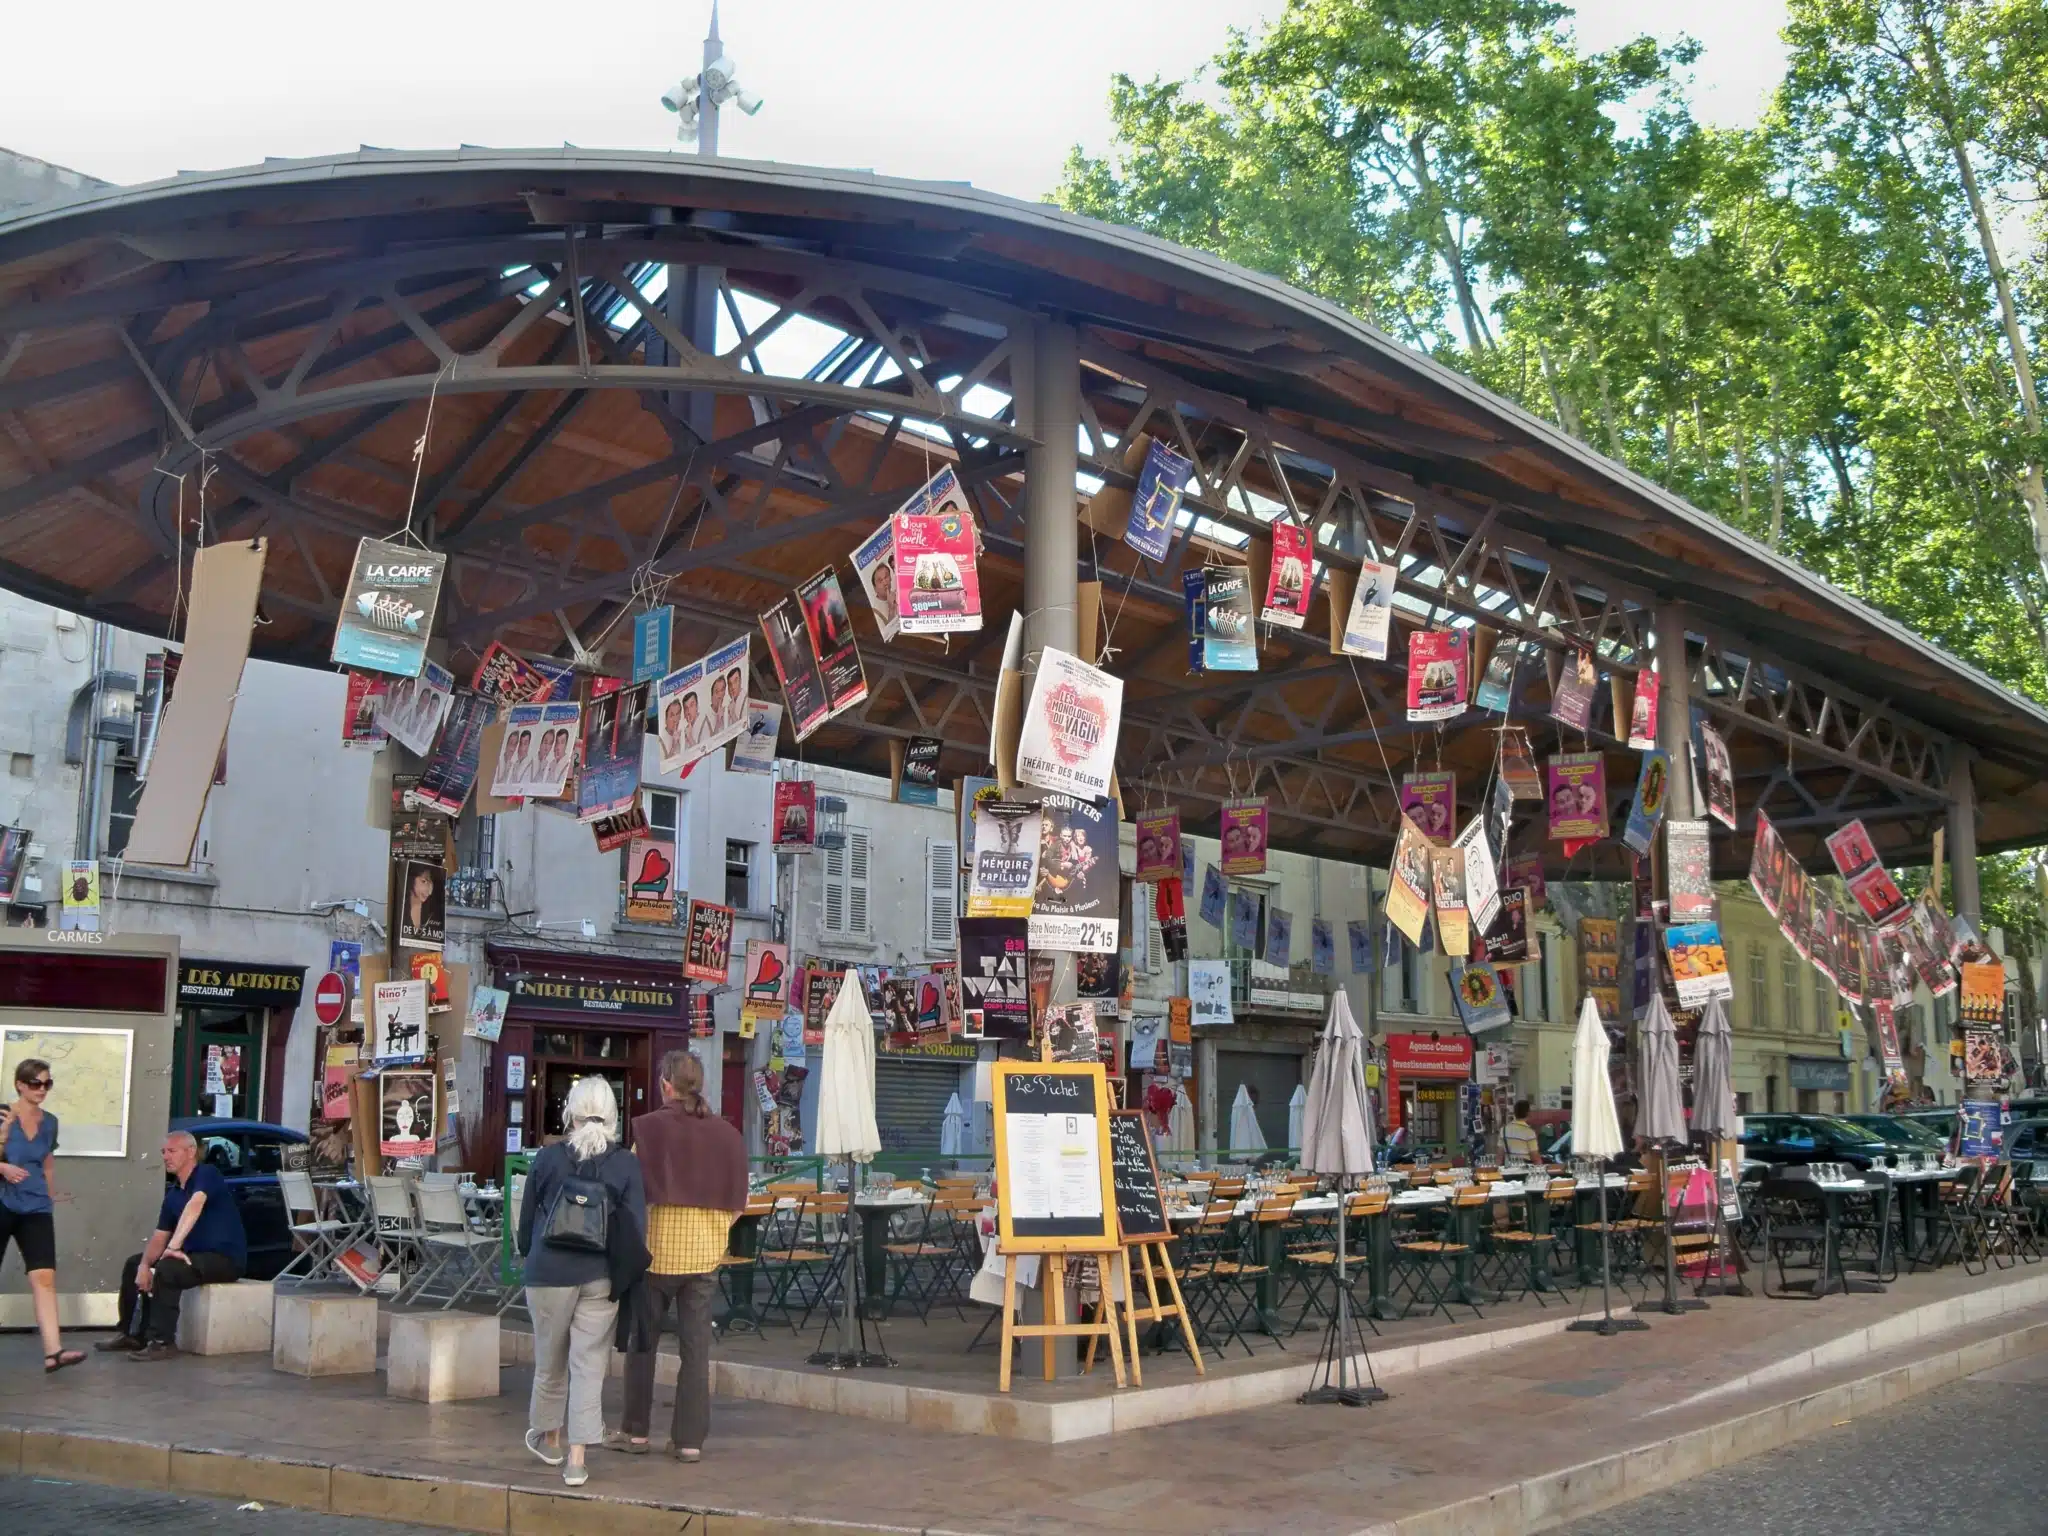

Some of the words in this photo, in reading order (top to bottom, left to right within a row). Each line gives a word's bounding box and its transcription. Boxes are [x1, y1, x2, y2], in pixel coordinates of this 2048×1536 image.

[367, 565, 384, 576] LA
[388, 565, 433, 577] CARPE
[1208, 585, 1217, 595] LA
[1217, 578, 1243, 593] CARPE
[1060, 690, 1075, 704] LES
[1051, 701, 1099, 726] MONOLOGUES
[1053, 713, 1063, 724] DU
[1065, 717, 1100, 743] VAGIN
[919, 745, 938, 754] CARPE
[1023, 757, 1057, 774] THÉÂTRE
[1058, 765, 1073, 778] DES
[1074, 769, 1104, 788] BÉLIERS
[1042, 794, 1103, 823] SQUATTERS
[982, 857, 1029, 870] MÉMOIRE
[980, 872, 1028, 883] PAPILLON
[629, 900, 671, 910] Psycholove
[1503, 891, 1522, 905] DUO
[703, 907, 716, 918] LES
[1040, 902, 1050, 911] Du
[1051, 903, 1069, 913] Plaisir
[1070, 903, 1075, 912] à
[1075, 898, 1100, 911] Plusieurs
[695, 912, 731, 928] DENEUVE
[403, 925, 412, 935] DE
[1044, 922, 1081, 936] Notre-Dame
[47, 930, 102, 944] CARMES
[980, 955, 1026, 977] TAI
[188, 968, 222, 986] DES
[226, 972, 301, 991] ARTISTES
[181, 985, 235, 997] RESTAURANT
[963, 976, 1027, 998] WAN
[378, 990, 401, 999] Nino
[579, 986, 605, 1001] DES
[610, 988, 673, 1006] ARTISTES
[583, 1000, 623, 1010] RESTAURANT
[924, 1044, 976, 1057] CONDUITE
[1409, 1041, 1435, 1052] Agence
[1436, 1042, 1464, 1052] Conseils
[1393, 1060, 1444, 1070] Investissement
[1033, 1074, 1079, 1096] Pichet
